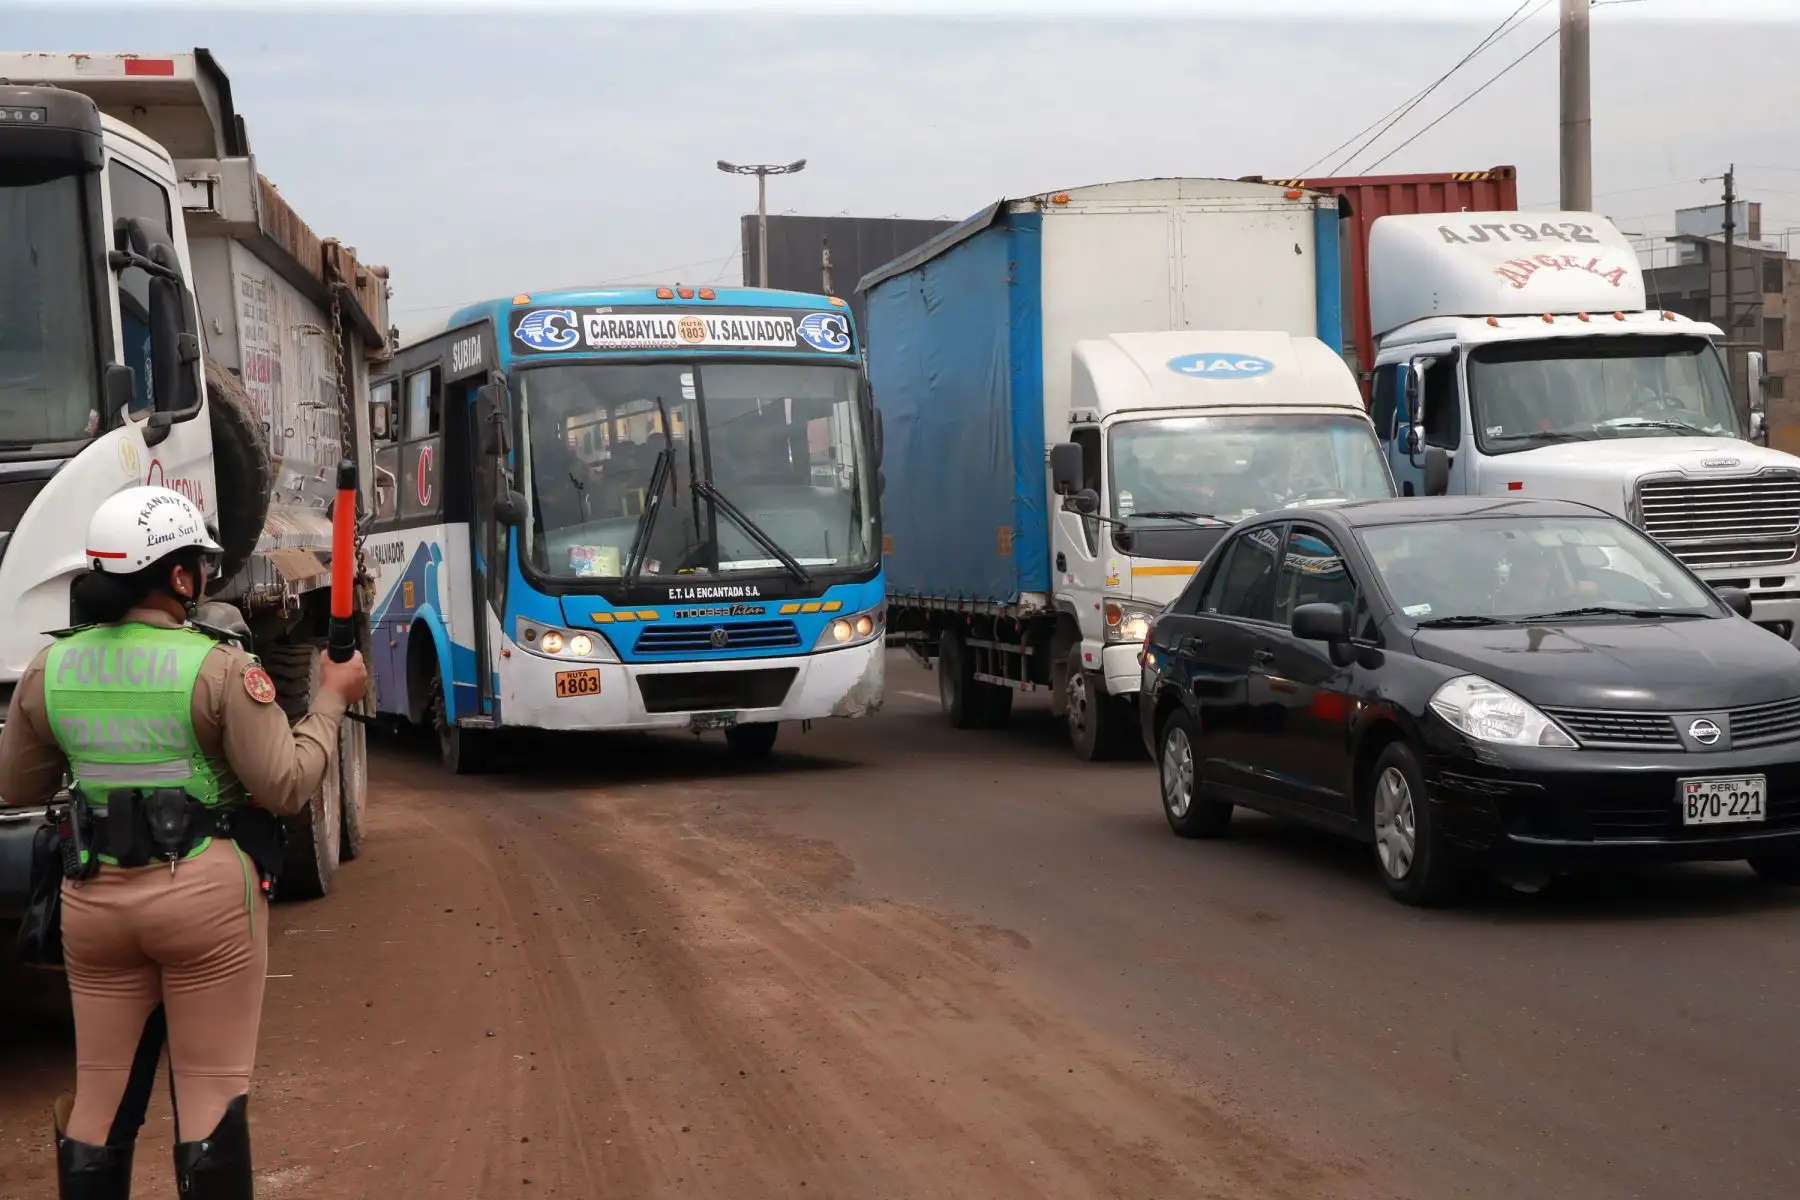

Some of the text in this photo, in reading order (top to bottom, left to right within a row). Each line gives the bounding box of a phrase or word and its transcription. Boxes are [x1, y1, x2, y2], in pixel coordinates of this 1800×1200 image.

[1437, 222, 1601, 245] AJT942
[590, 319, 676, 340] CARABAYLLO
[722, 320, 796, 342] SALVADOR
[680, 320, 703, 328] RUTA
[680, 327, 705, 340] 1803
[452, 334, 482, 373] SUBIDA
[1180, 358, 1266, 373] JAC
[137, 494, 191, 527] TRANSITO
[146, 531, 176, 548] Lima
[375, 541, 405, 565] SALVADOR
[668, 585, 760, 600] E.T. LA ENCANTADA S.A.
[56, 645, 181, 686] POLICIA
[566, 671, 588, 679] RUTA
[558, 676, 598, 695] 1803
[58, 715, 187, 755] TRANSITO
[1710, 783, 1739, 793] PERU
[1687, 791, 1762, 819] B70-221
